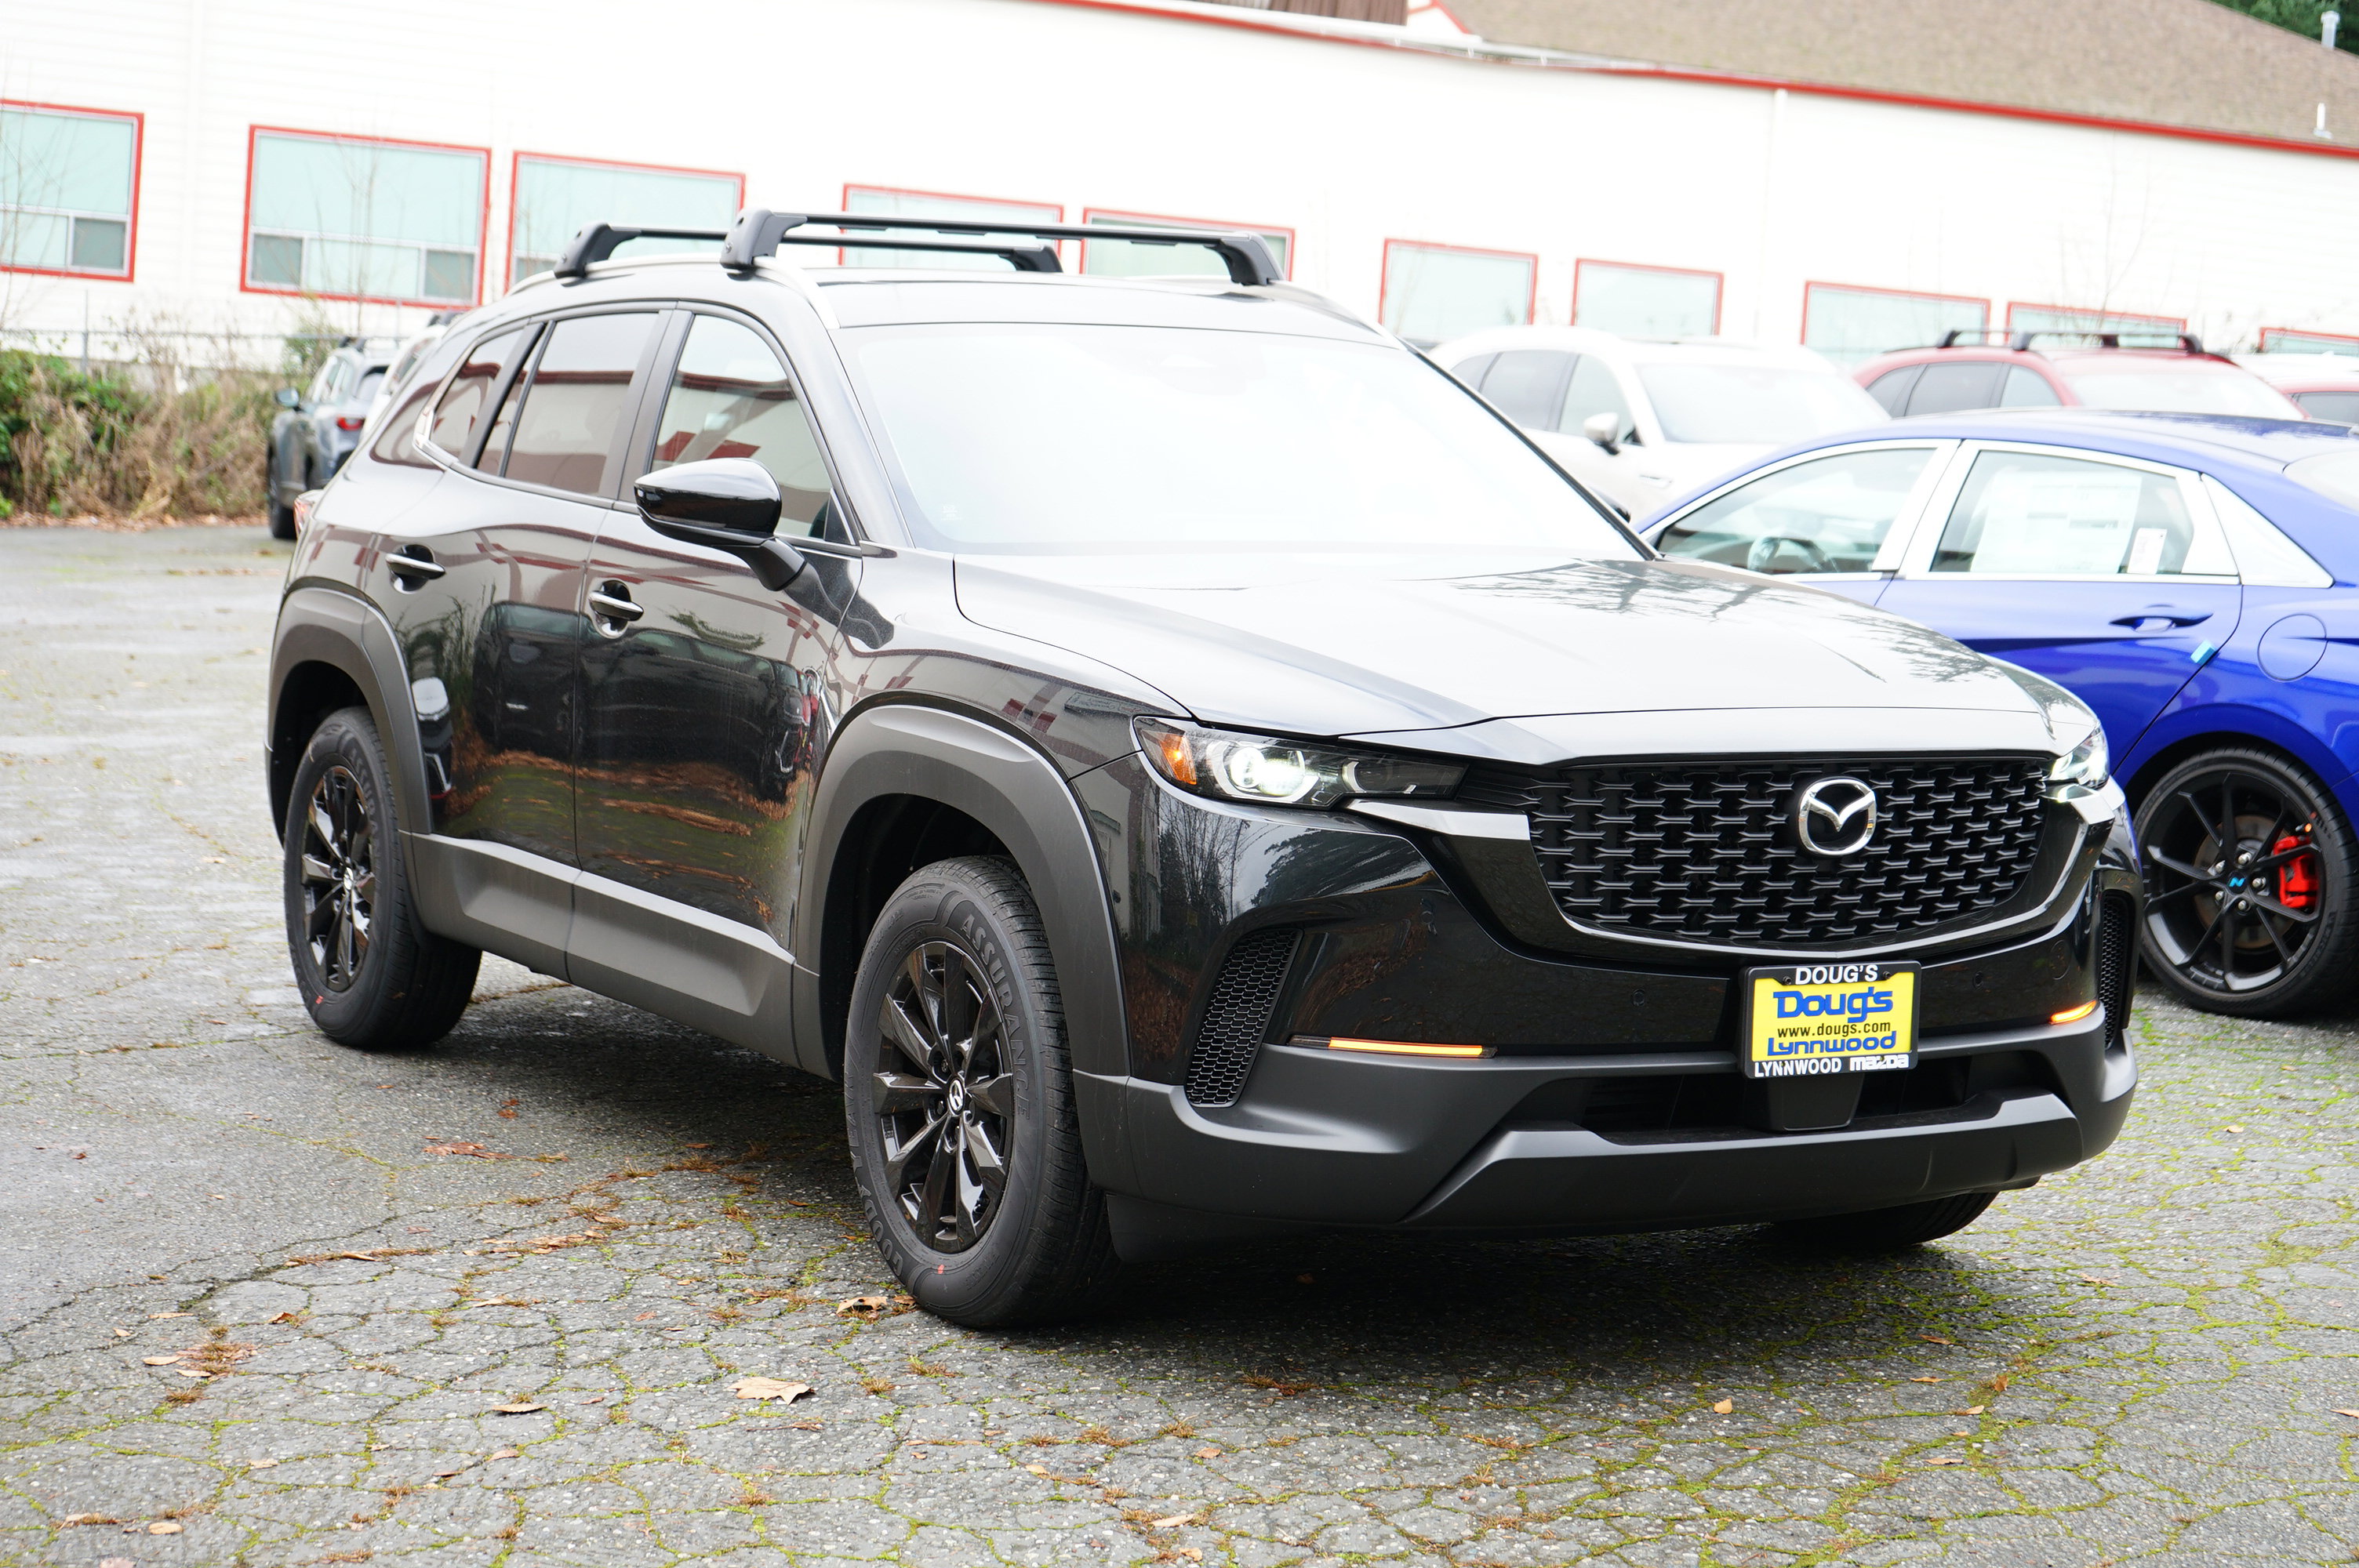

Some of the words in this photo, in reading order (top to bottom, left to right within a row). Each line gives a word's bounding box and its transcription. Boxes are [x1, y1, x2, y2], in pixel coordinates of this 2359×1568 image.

[1795, 964, 1878, 985] DOUG'S
[1772, 986, 1893, 1023] Doug's
[959, 913, 1030, 1120] ASSURANCE
[1777, 1022, 1891, 1037] www.dougs.com
[1767, 1030, 1896, 1056] Lynnwood
[1754, 1058, 1842, 1078] LYNNWOOD
